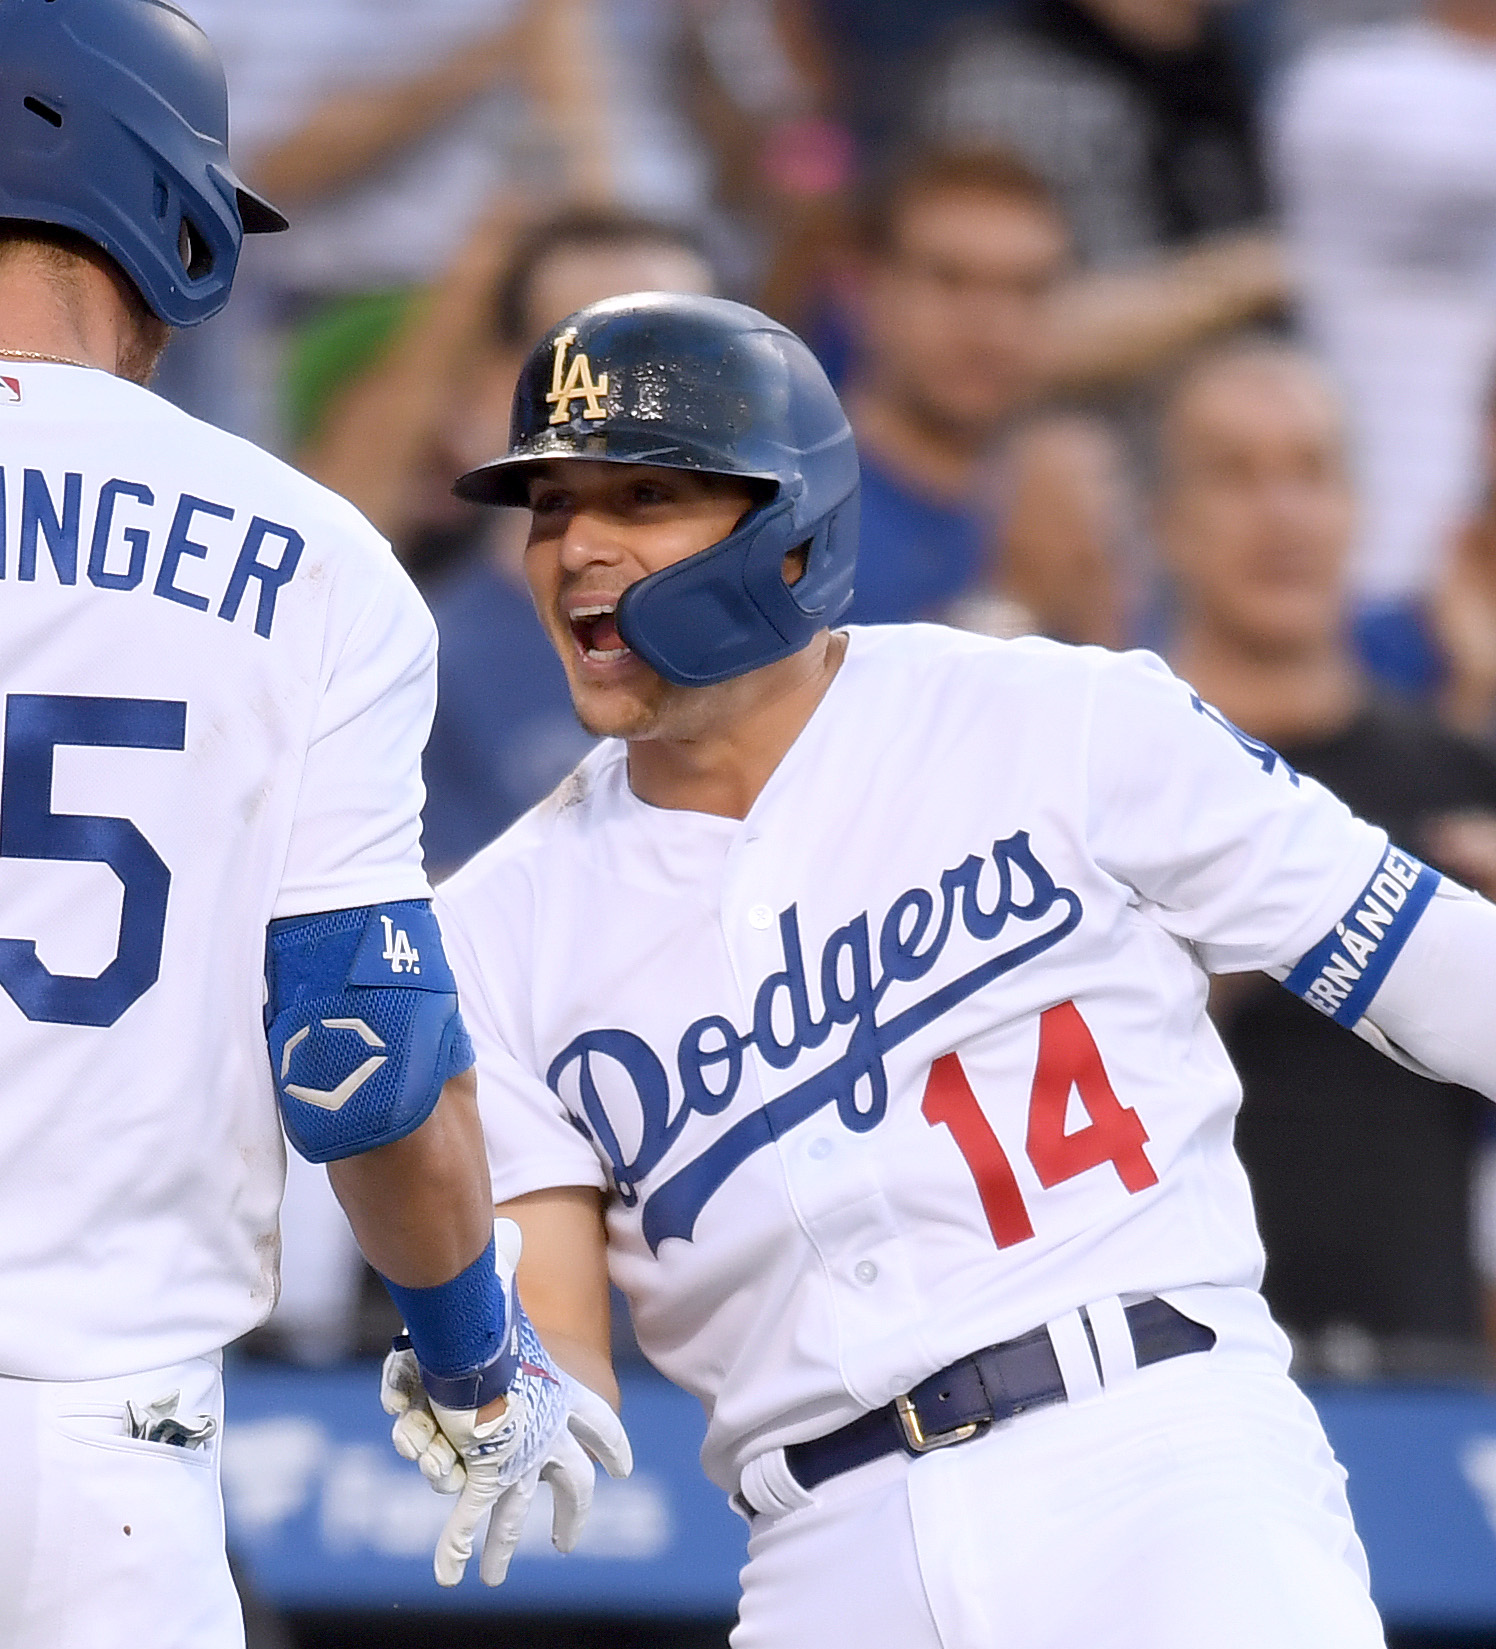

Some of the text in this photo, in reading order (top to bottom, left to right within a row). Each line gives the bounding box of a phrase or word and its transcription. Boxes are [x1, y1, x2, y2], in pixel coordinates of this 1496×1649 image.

[546, 330, 608, 426] LA
[380, 915, 421, 975] LA
[1305, 846, 1422, 1015] ERNÁNDEZ
[546, 830, 1084, 1257] Dodgers
[922, 999, 1160, 1250] 14
